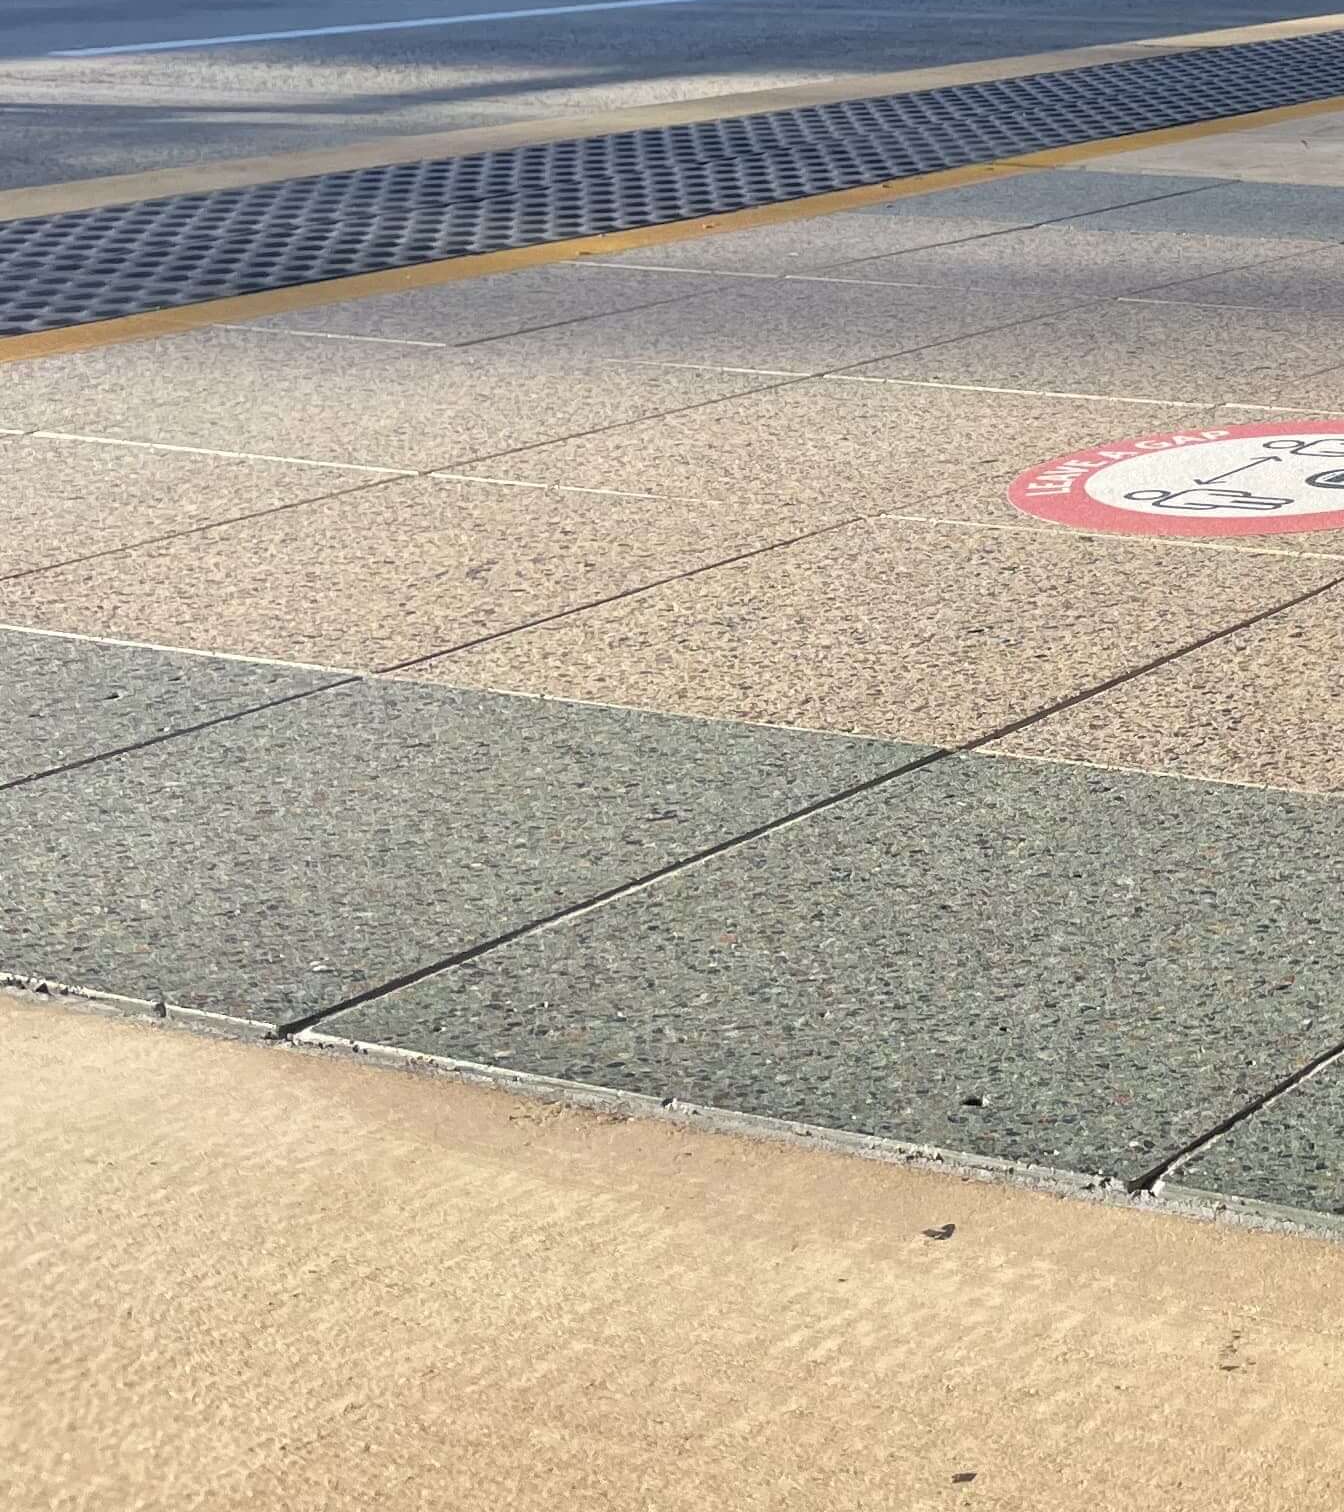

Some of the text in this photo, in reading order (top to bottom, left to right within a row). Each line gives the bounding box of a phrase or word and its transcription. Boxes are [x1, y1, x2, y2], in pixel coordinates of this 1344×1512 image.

[1026, 429, 1230, 496] LEAVE A GAP
